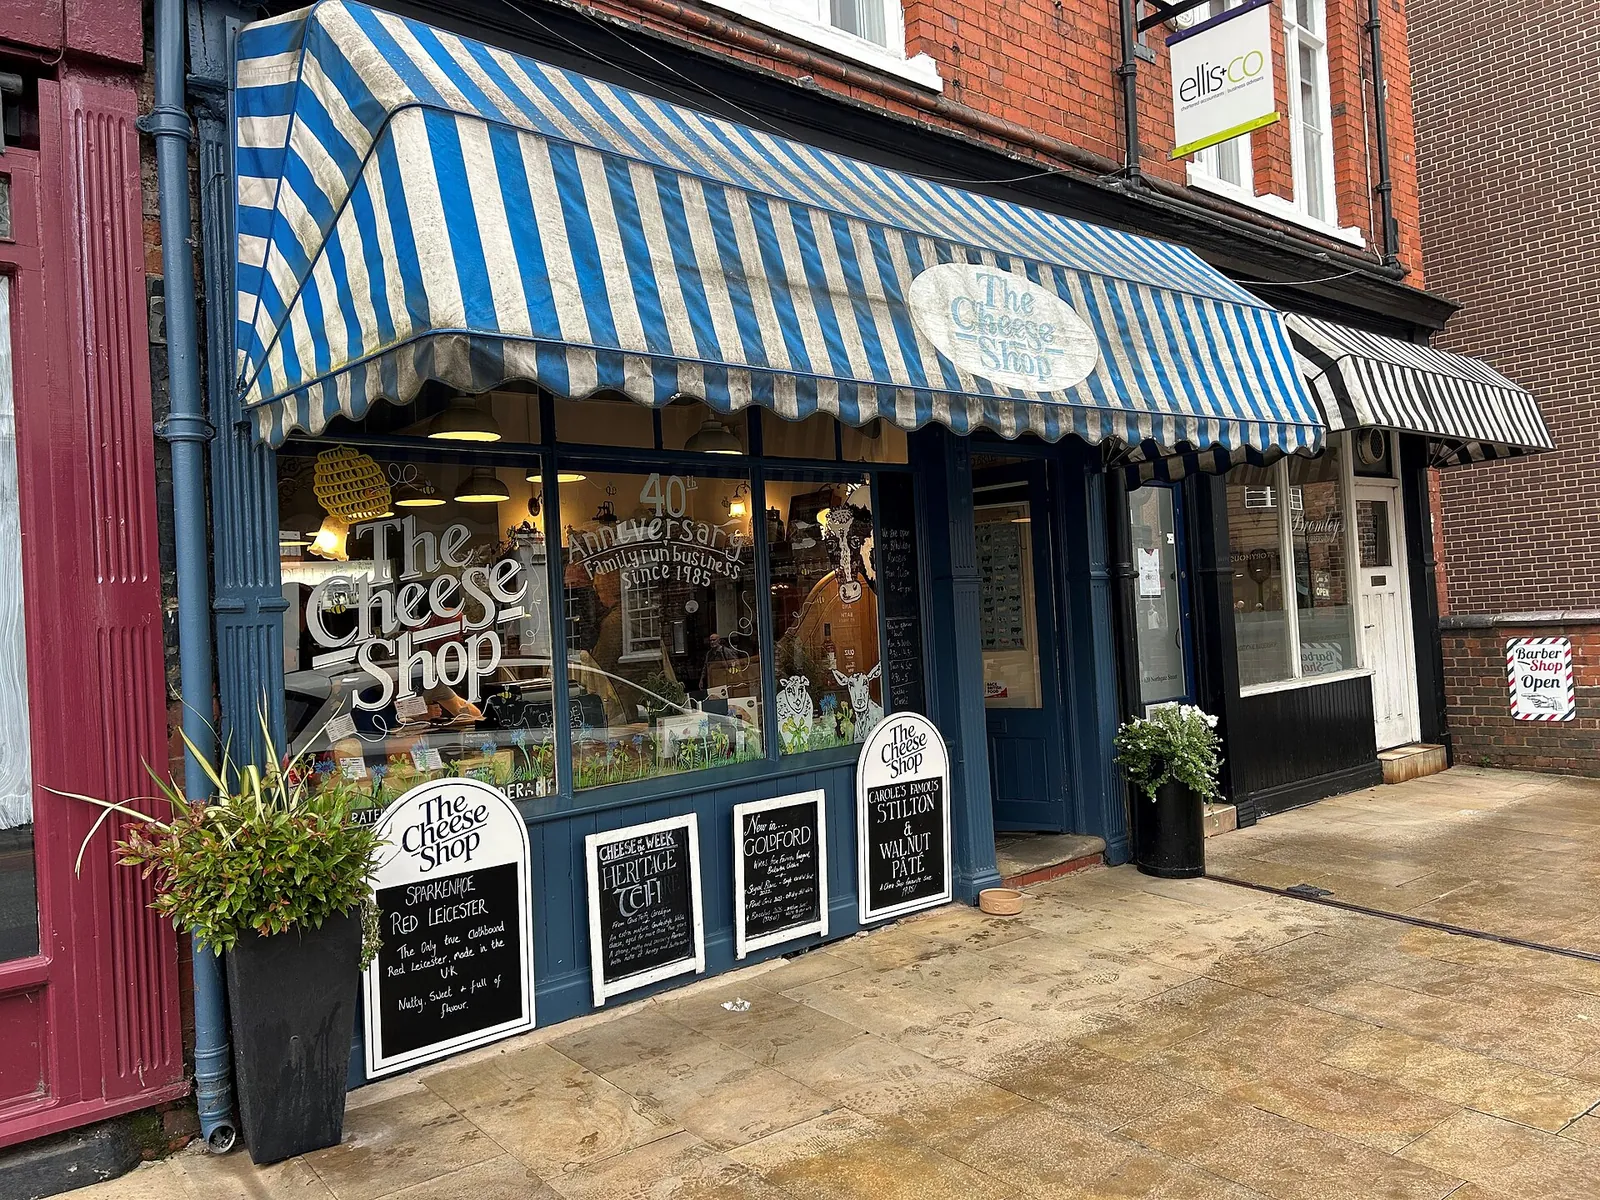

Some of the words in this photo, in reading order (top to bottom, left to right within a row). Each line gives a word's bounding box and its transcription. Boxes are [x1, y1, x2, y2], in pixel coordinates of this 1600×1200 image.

[1180, 101, 1200, 112] chartered
[1200, 91, 1225, 104] accountants
[1227, 83, 1246, 94] business
[976, 272, 1036, 315] The
[951, 296, 1055, 352] Cheese
[978, 336, 1053, 384] Shop
[639, 472, 698, 518] 40th
[356, 514, 474, 583] The
[568, 517, 744, 564] Anniversary
[584, 550, 641, 581] Family
[641, 548, 670, 563] run
[673, 546, 741, 580] business
[676, 565, 712, 588] 1985
[306, 557, 528, 649] Cheese
[1316, 587, 1329, 597] OPEN
[1515, 647, 1562, 660] Barber
[1530, 660, 1563, 675] Shop
[352, 629, 502, 712] Shop
[1521, 674, 1561, 692] Open
[881, 732, 928, 764] Cheese
[890, 723, 916, 745] The
[890, 752, 923, 779] Shop
[868, 784, 907, 804] CAROLE'S
[910, 780, 939, 795] FAMOUS
[418, 795, 468, 826] The
[876, 792, 935, 824] STILTON
[402, 804, 490, 852] Cheese
[744, 814, 768, 836] Now
[903, 821, 913, 837] &
[419, 832, 480, 873] Shop
[599, 838, 637, 861] CHEESE
[645, 831, 675, 849] WEEK
[744, 826, 811, 856] GOLDFORD
[879, 832, 932, 860] WALNUT
[602, 849, 677, 891] HERITAGE
[405, 875, 476, 906] SPARKENHOE
[390, 912, 419, 935] RED
[397, 943, 415, 960] The
[444, 934, 461, 946] true
[468, 921, 506, 940] Clothbound
[388, 965, 406, 977] Red
[454, 947, 475, 961] made
[480, 943, 488, 953] in
[490, 939, 506, 950] the
[430, 986, 453, 1002] Sweet
[470, 978, 487, 993] full
[494, 974, 502, 988] of
